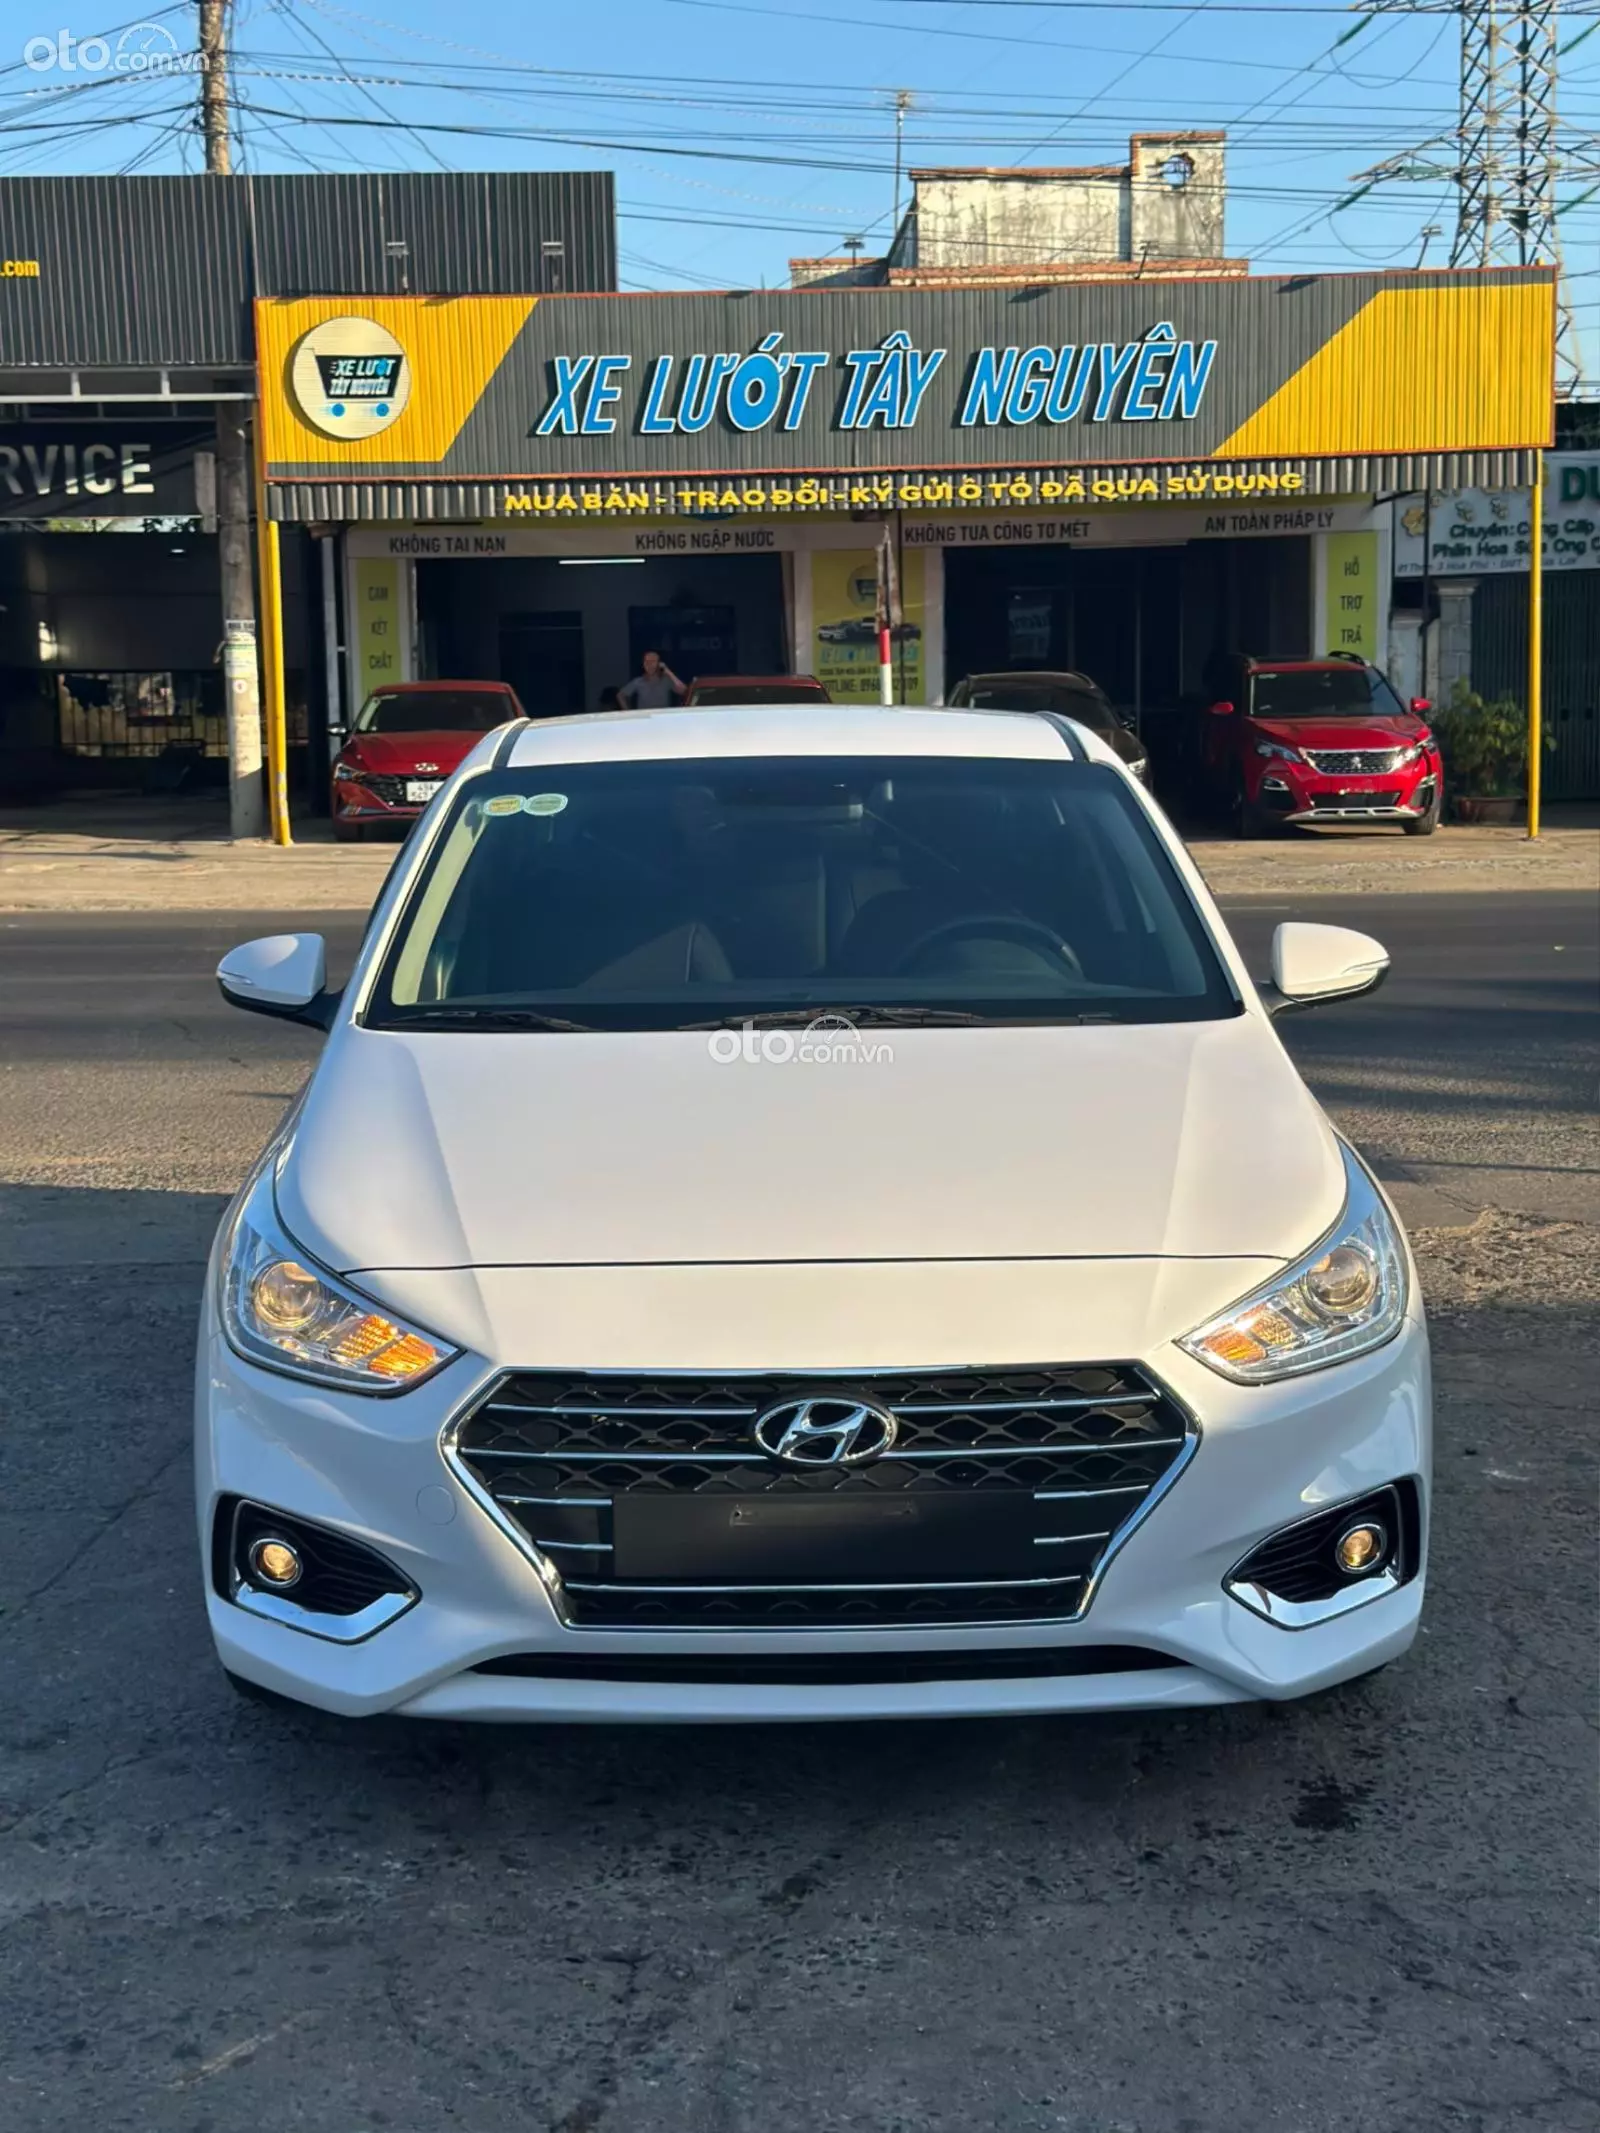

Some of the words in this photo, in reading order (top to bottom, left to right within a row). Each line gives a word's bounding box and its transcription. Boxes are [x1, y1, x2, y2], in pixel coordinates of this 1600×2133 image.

[335, 360, 356, 376] XE
[536, 355, 632, 435] XE
[640, 332, 830, 434] LƯỚT
[839, 330, 947, 430] TÂY
[960, 321, 1218, 426] NGUYÊN
[505, 495, 578, 510] MUA
[677, 489, 766, 508] TRAO
[851, 479, 893, 503] KÝ
[958, 476, 982, 500] Ô
[1040, 475, 1086, 498] ĐÃ
[1091, 478, 1159, 501] QUA
[1167, 469, 1210, 493] SỬ
[1213, 472, 1303, 497] DỤNG
[904, 523, 956, 543] KHÔNG
[960, 525, 990, 541] TUA
[993, 520, 1032, 540] CÔNG
[1204, 516, 1226, 532] AN
[1230, 508, 1269, 532] TOÀN
[1273, 509, 1315, 530] PHÁP
[388, 532, 441, 553] KHÔNG
[444, 537, 469, 553] TAI
[474, 536, 506, 556] NẠN
[635, 530, 687, 551] KHÔNG
[690, 528, 732, 552] NGẬP
